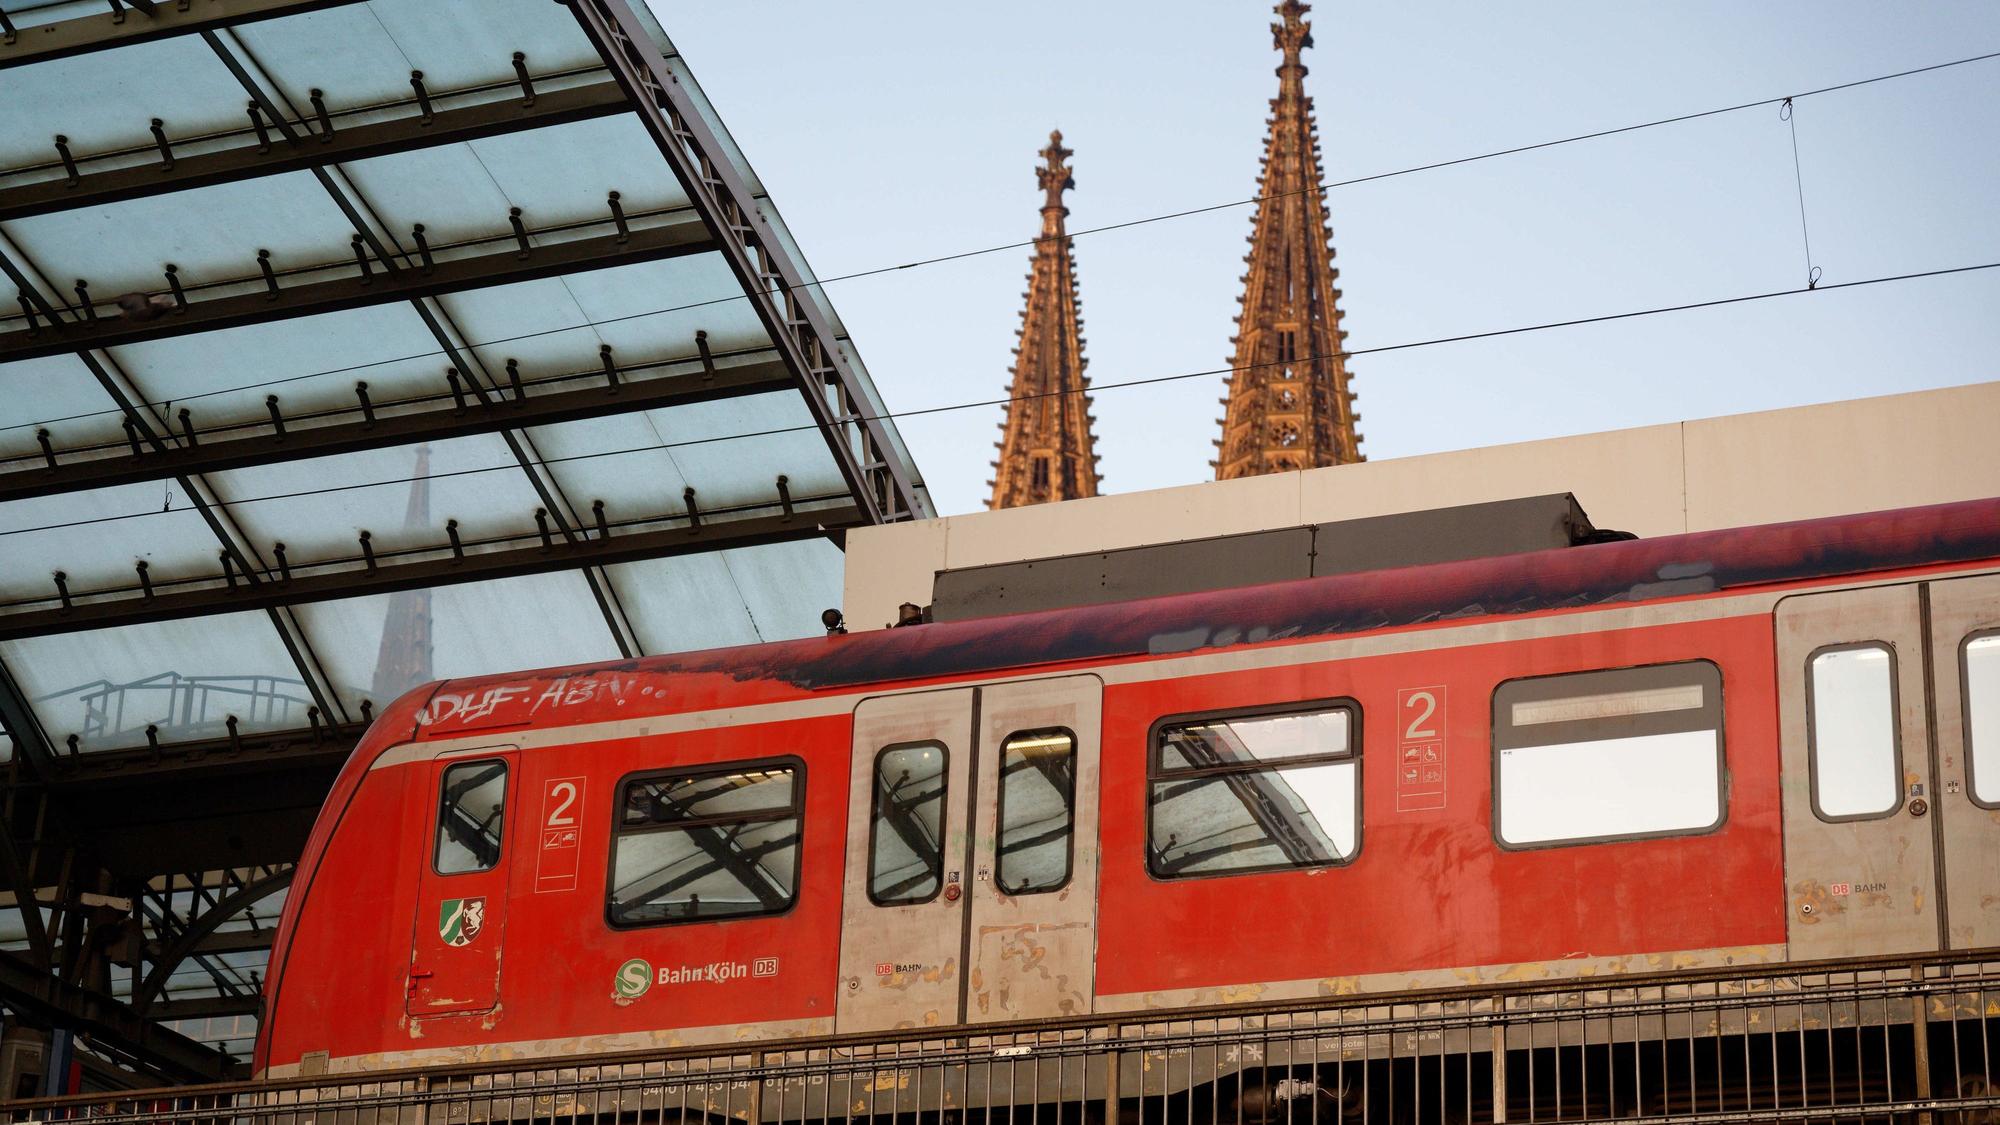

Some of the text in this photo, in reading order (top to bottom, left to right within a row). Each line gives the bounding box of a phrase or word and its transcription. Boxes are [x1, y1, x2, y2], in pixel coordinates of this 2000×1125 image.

[1405, 691, 1436, 738] 2
[547, 782, 577, 826] 2
[1831, 882, 1887, 897] DB BAHN
[618, 958, 777, 997] S Bahn Köln DB
[876, 963, 922, 976] DB BAHN
